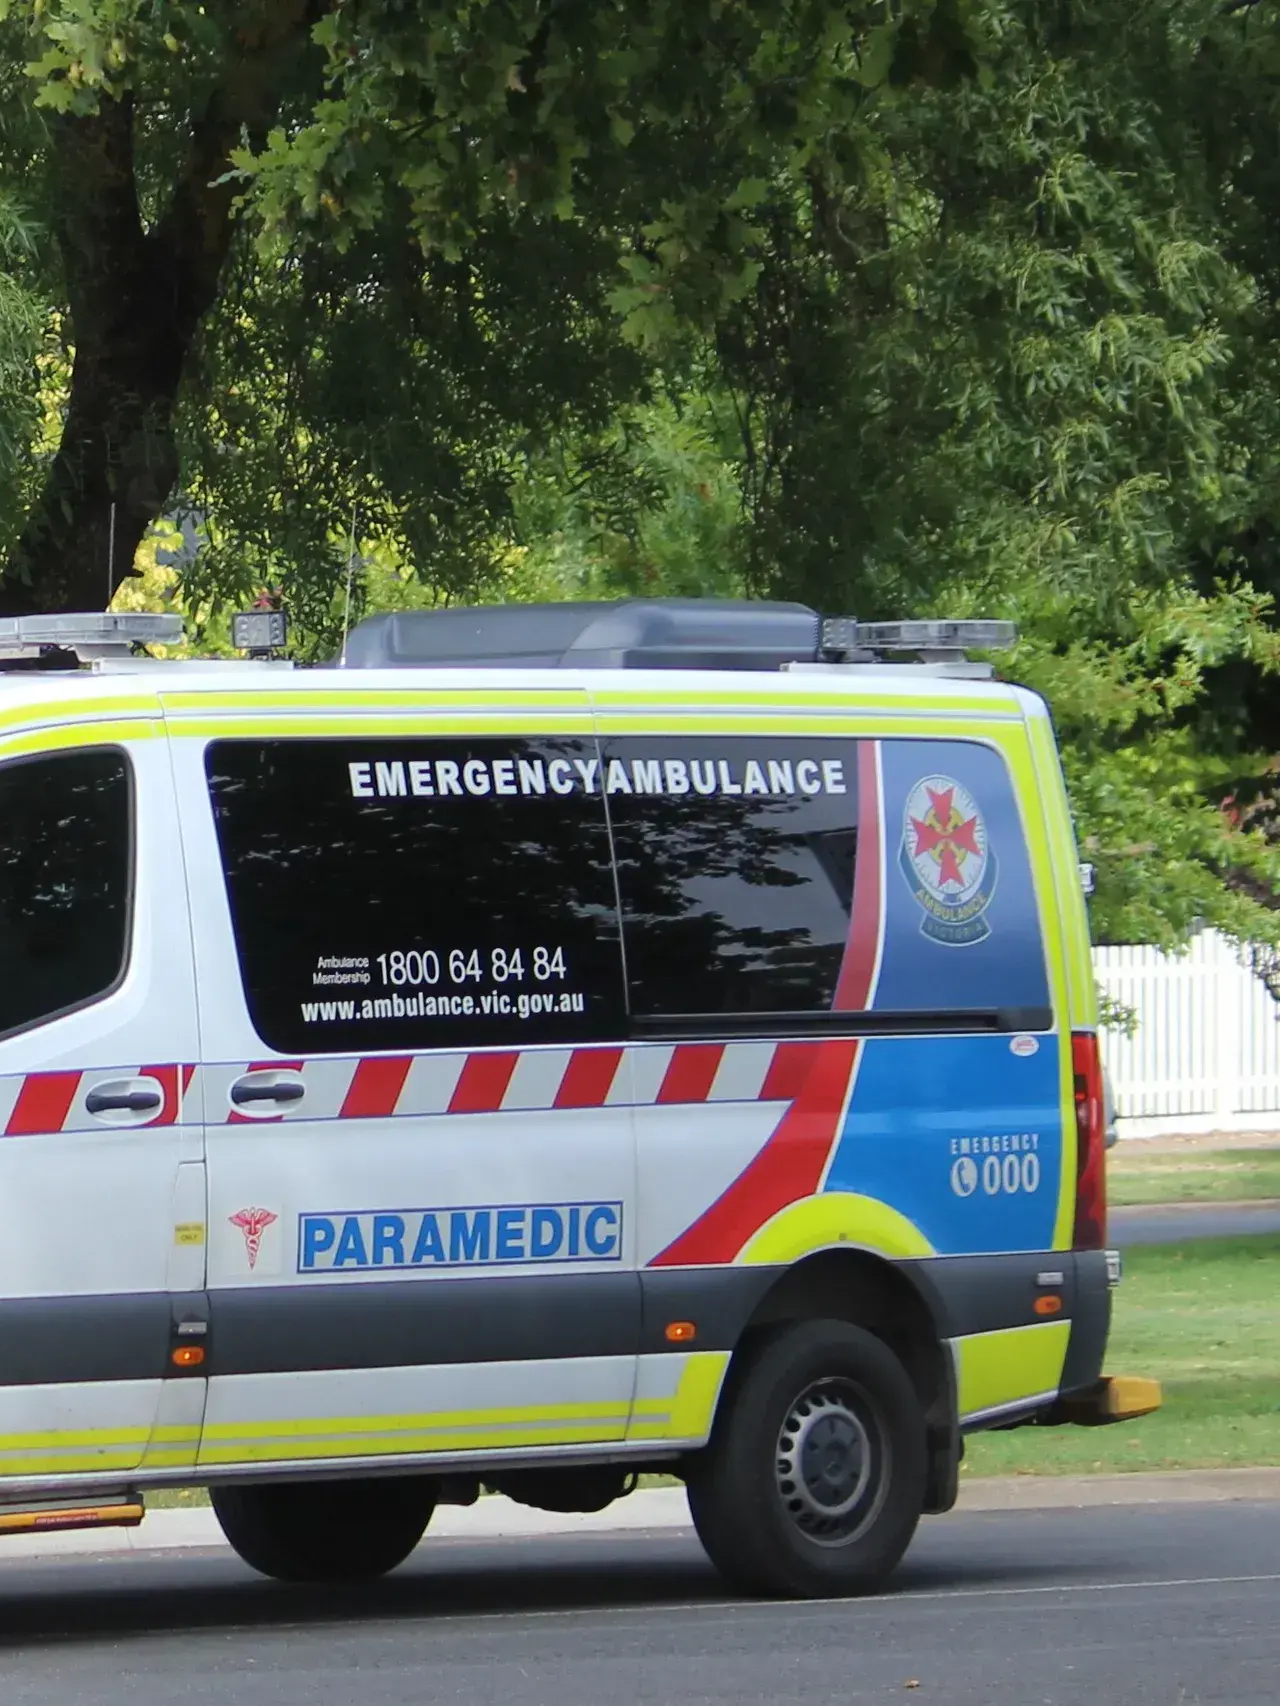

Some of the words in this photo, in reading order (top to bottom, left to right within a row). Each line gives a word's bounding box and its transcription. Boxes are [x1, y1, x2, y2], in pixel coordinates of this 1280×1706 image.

[348, 758, 601, 798] EMERGENCY
[606, 758, 847, 796] AMBULANCE
[916, 889, 988, 922] AMBULANCE
[312, 970, 371, 985] Membership
[317, 956, 370, 969] Ambulance
[376, 950, 440, 985] 1800
[448, 949, 483, 983] 64
[491, 948, 525, 982] 84
[533, 946, 567, 980] 84
[301, 990, 584, 1023] www.ambulance.vic.gov.au
[951, 1134, 1040, 1155] EMERGENCY
[982, 1153, 1041, 1196] 000
[302, 1206, 618, 1268] PARAMEDIC
